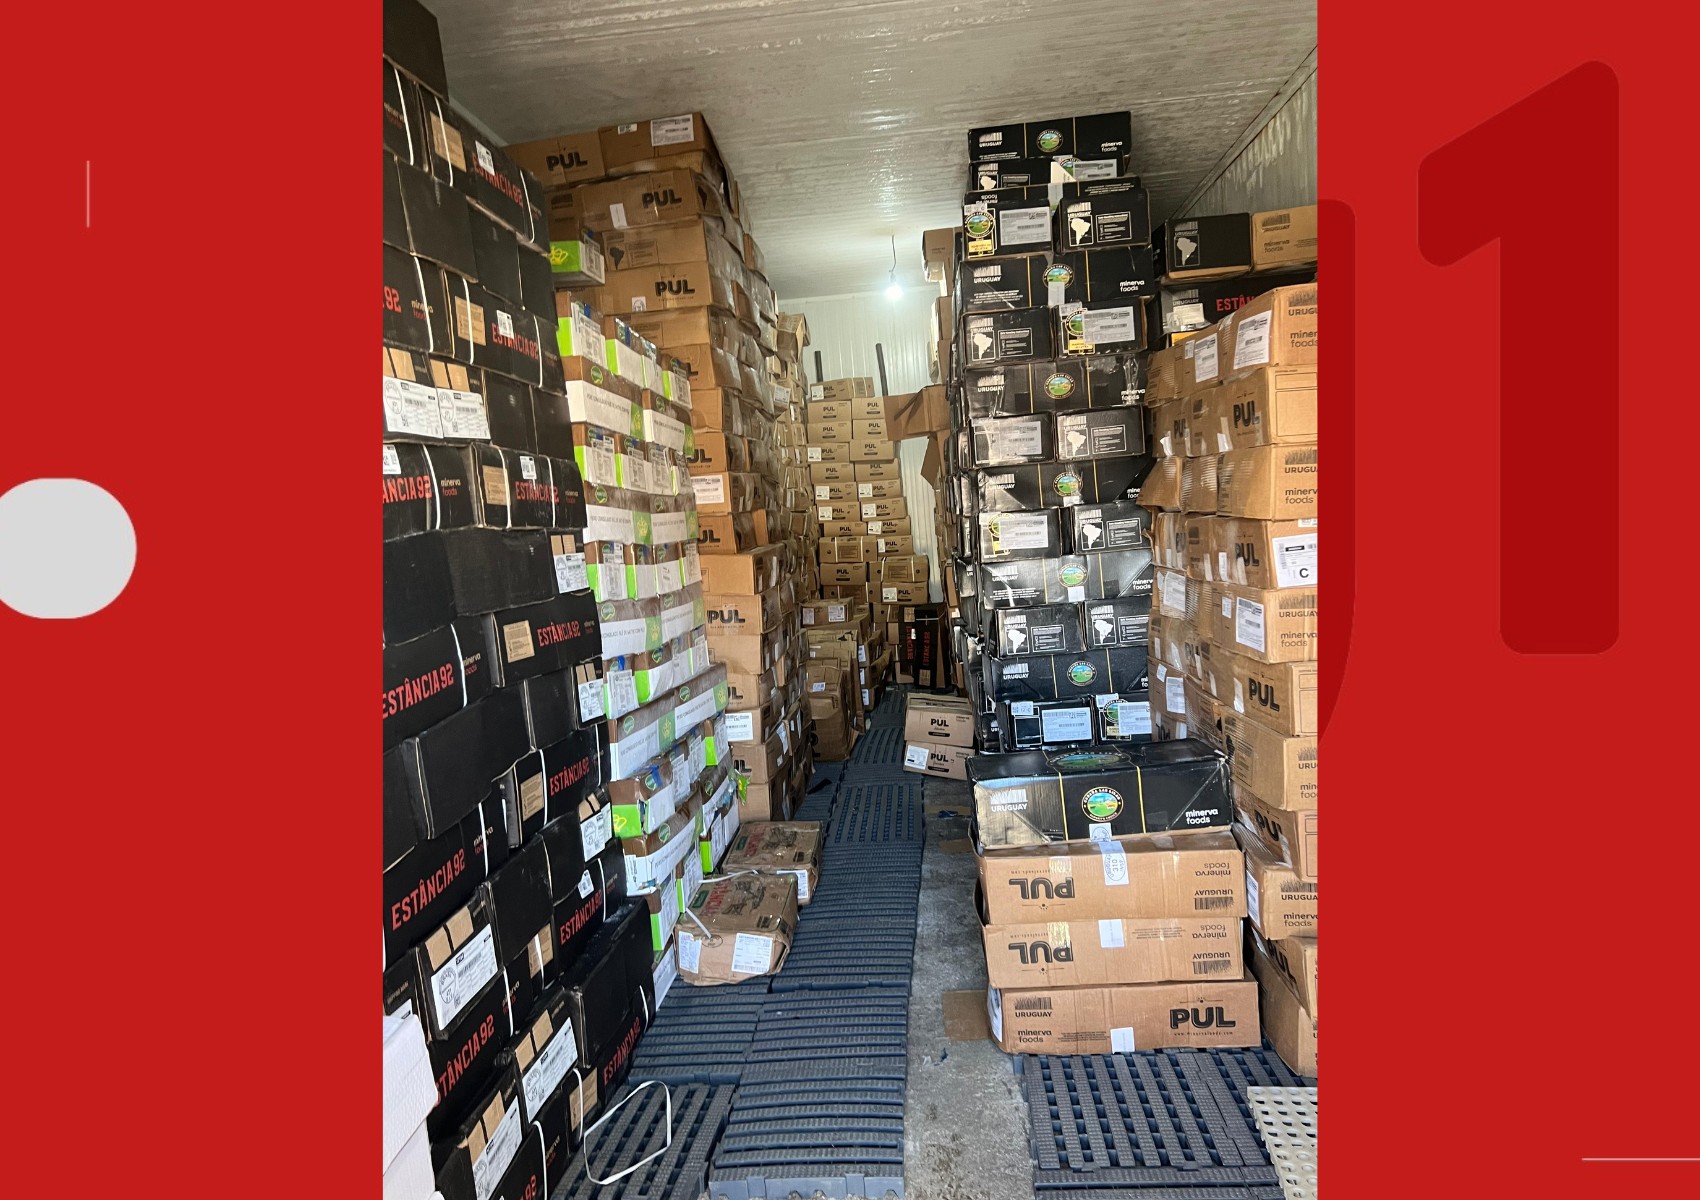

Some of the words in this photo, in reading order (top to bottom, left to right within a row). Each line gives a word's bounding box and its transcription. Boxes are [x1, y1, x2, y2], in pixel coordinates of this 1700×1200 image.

[546, 151, 588, 171] PUL
[642, 188, 682, 209] PUL
[973, 276, 1002, 284] URUGUAY
[1119, 279, 1145, 288] minerva
[655, 279, 696, 297] PUL
[1120, 285, 1139, 293] foods
[977, 385, 1004, 393] URUGUAY
[687, 448, 712, 463] UL
[441, 478, 461, 487] minerva
[1285, 496, 1314, 504] foods
[699, 529, 721, 543] UL
[1299, 568, 1309, 578] C
[707, 609, 745, 625] PUL
[1281, 639, 1308, 648] foods
[1249, 677, 1280, 712] PUL
[930, 718, 949, 727] PUL
[930, 753, 949, 762] PUL
[991, 803, 1028, 812] URUGUAY
[1185, 808, 1219, 818] minerva
[1186, 816, 1211, 825] foods
[1111, 859, 1119, 872] 310
[1204, 861, 1231, 870] foods
[1195, 869, 1231, 877] minerva
[1008, 877, 1076, 900] PUL
[1194, 888, 1233, 896] URUGUAY
[1284, 919, 1312, 927] foods
[1200, 924, 1226, 932] foods
[1192, 931, 1227, 939] minerva
[1008, 941, 1074, 964] PUL
[1192, 952, 1231, 960] URUGUAY
[1170, 1006, 1236, 1029] PUL
